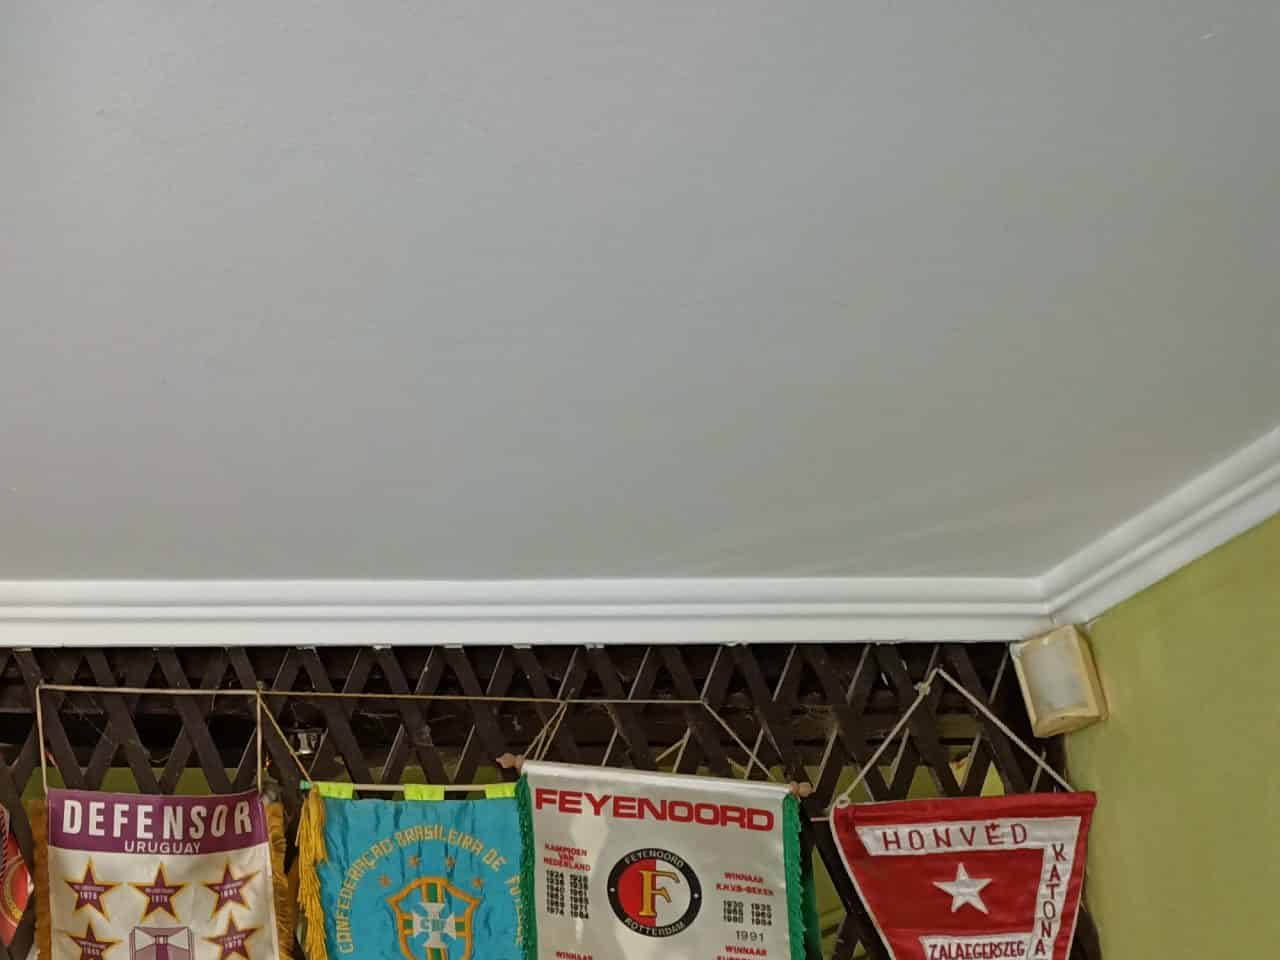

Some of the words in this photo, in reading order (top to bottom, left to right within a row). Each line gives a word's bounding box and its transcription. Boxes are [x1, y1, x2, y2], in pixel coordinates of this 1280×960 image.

[62, 799, 253, 840] DEFENSOR
[535, 788, 775, 833] FEYENOORD
[123, 840, 202, 855] URUGUAY
[881, 821, 1028, 851] HONVÉD
[483, 848, 508, 872] DE
[624, 848, 686, 870] FEYENOORD
[1033, 842, 1067, 957] KATONA
[623, 916, 687, 938] ROTTERDAM
[735, 930, 765, 942] 1991
[928, 939, 1026, 960] ZALAEGERSZEG
